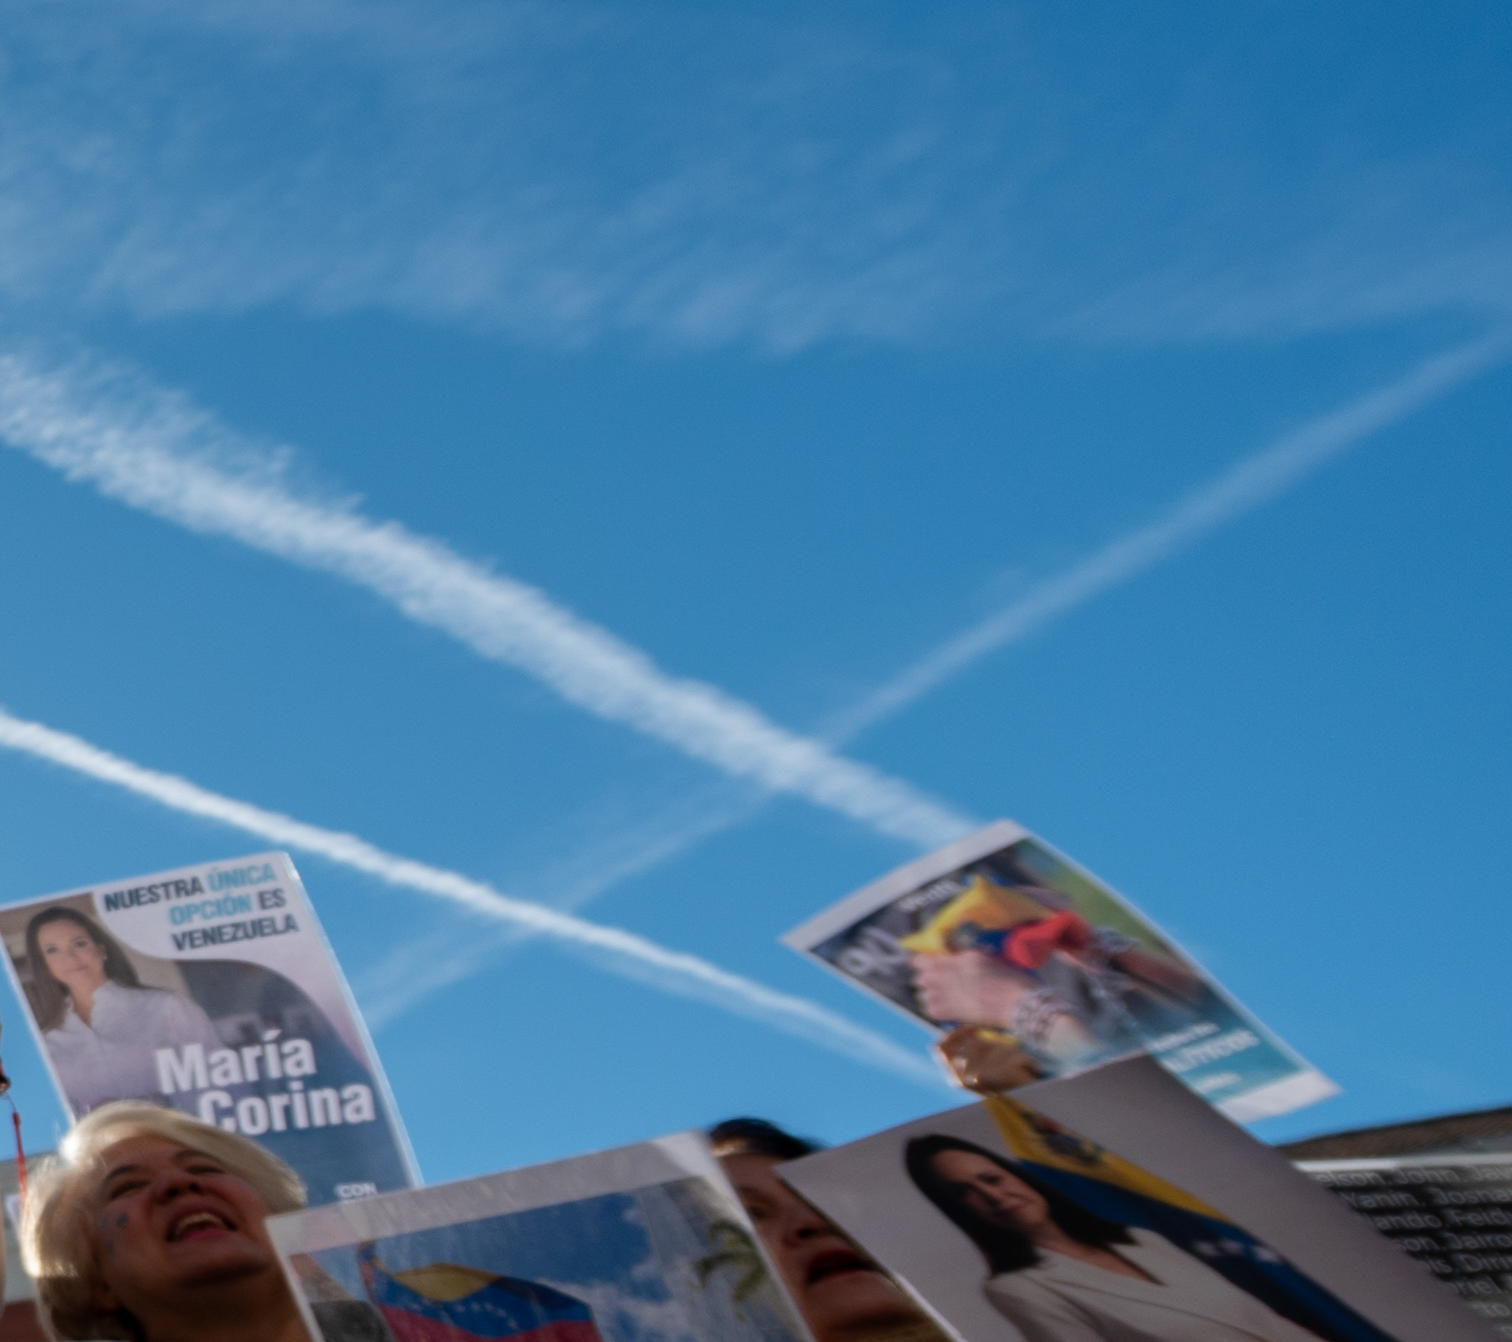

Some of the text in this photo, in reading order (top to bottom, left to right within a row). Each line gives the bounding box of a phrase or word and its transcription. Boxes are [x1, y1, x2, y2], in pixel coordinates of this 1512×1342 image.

[103, 862, 278, 913] NUESTRA ÚNICA
[168, 887, 287, 927] OPCIÓN ES
[171, 913, 301, 952] VENEZUELA
[154, 1028, 318, 1096] María
[197, 1080, 377, 1137] Corina
[335, 1181, 378, 1198] CON
